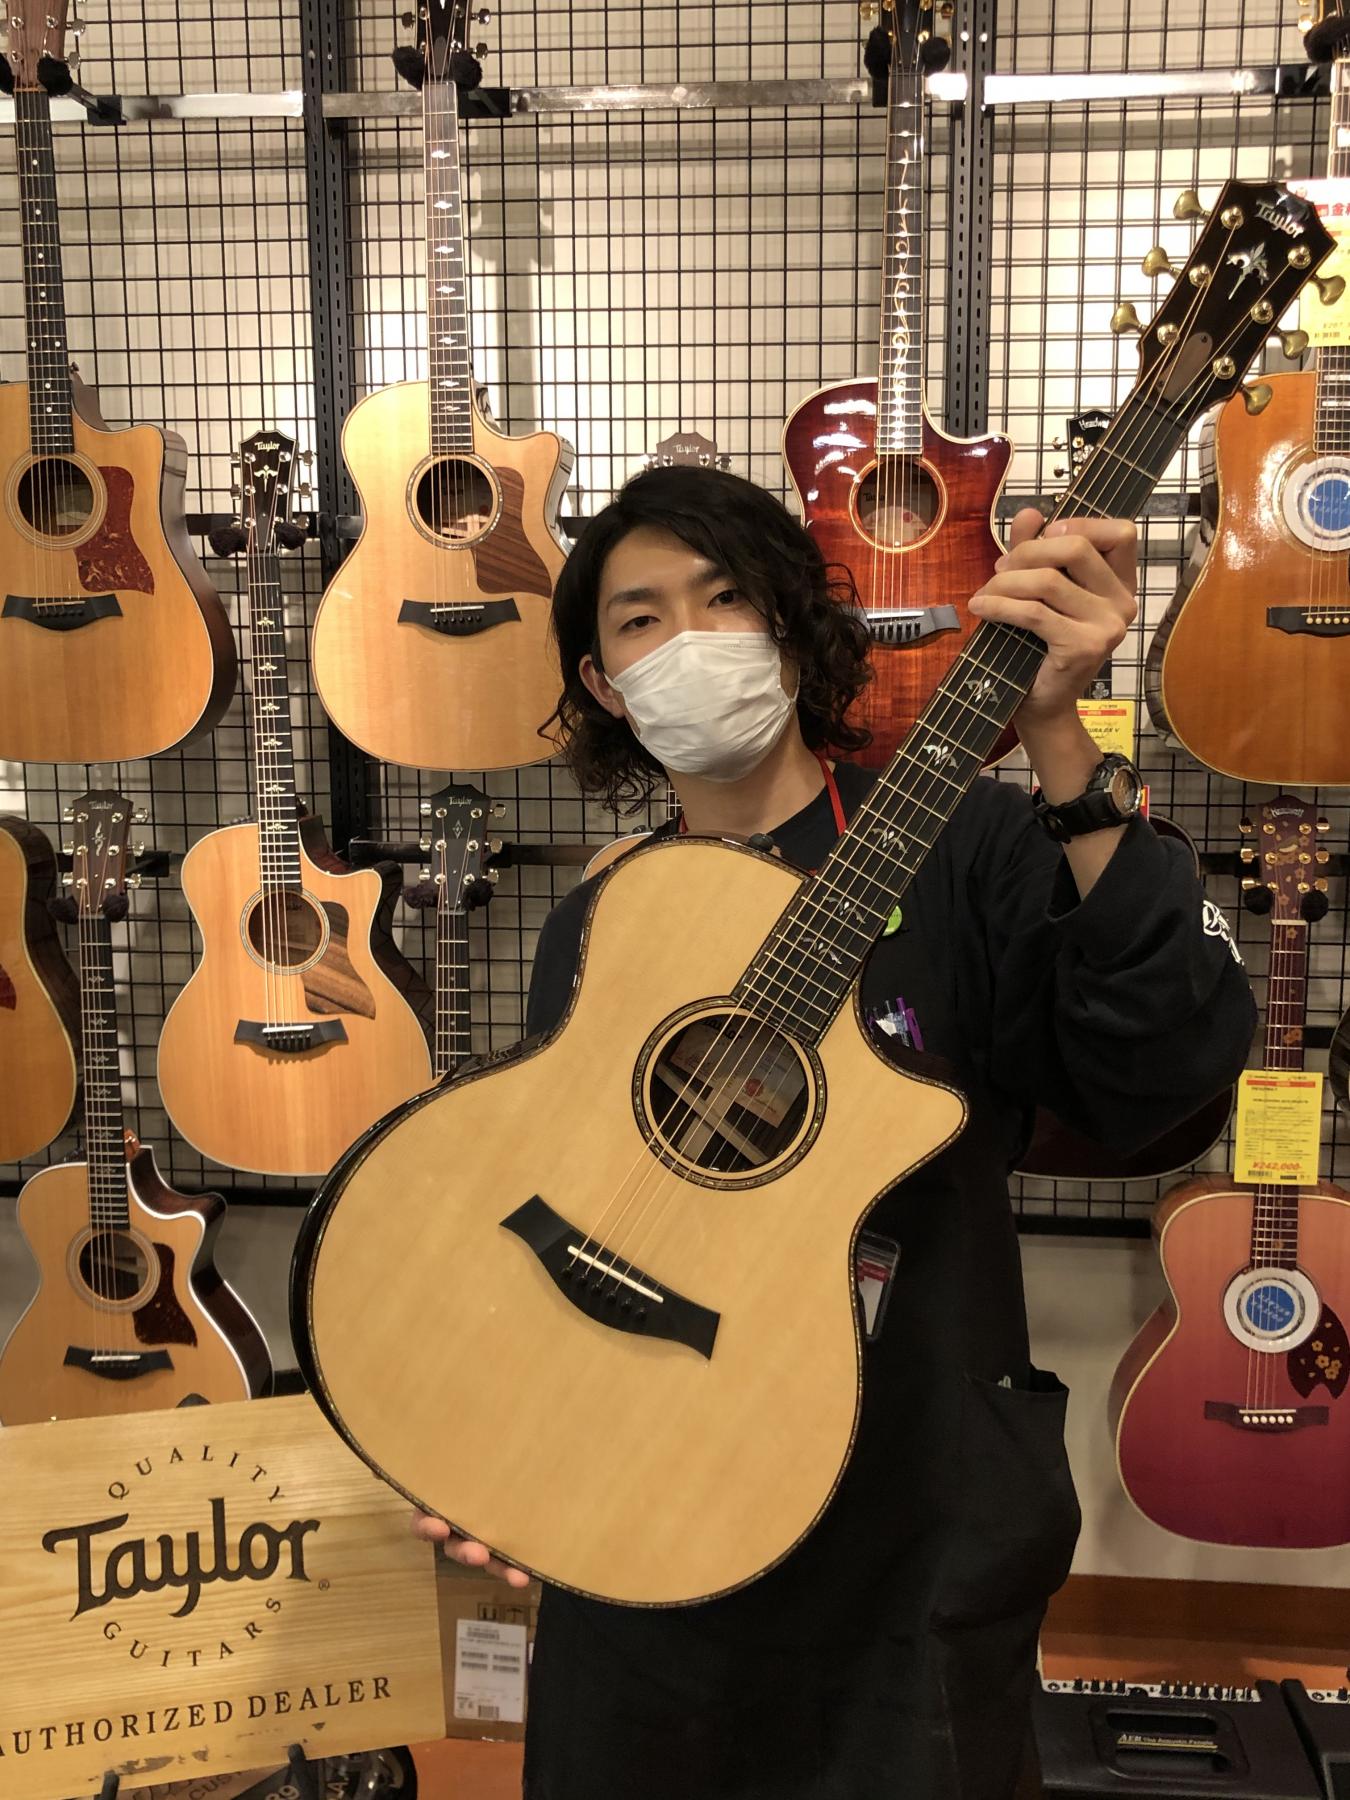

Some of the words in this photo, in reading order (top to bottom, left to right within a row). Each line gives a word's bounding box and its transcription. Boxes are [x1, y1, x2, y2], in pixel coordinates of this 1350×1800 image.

[1254, 199, 1305, 239] Taylor
[255, 441, 280, 453] Taylor
[673, 443, 700, 455] Taylor
[88, 800, 113, 811] Taylor
[448, 796, 473, 808] Taylor
[108, 1445, 286, 1503] QUALITY
[42, 1497, 321, 1622] Taylor
[103, 1597, 282, 1668] GUITARS
[248, 1676, 391, 1719] DEALER
